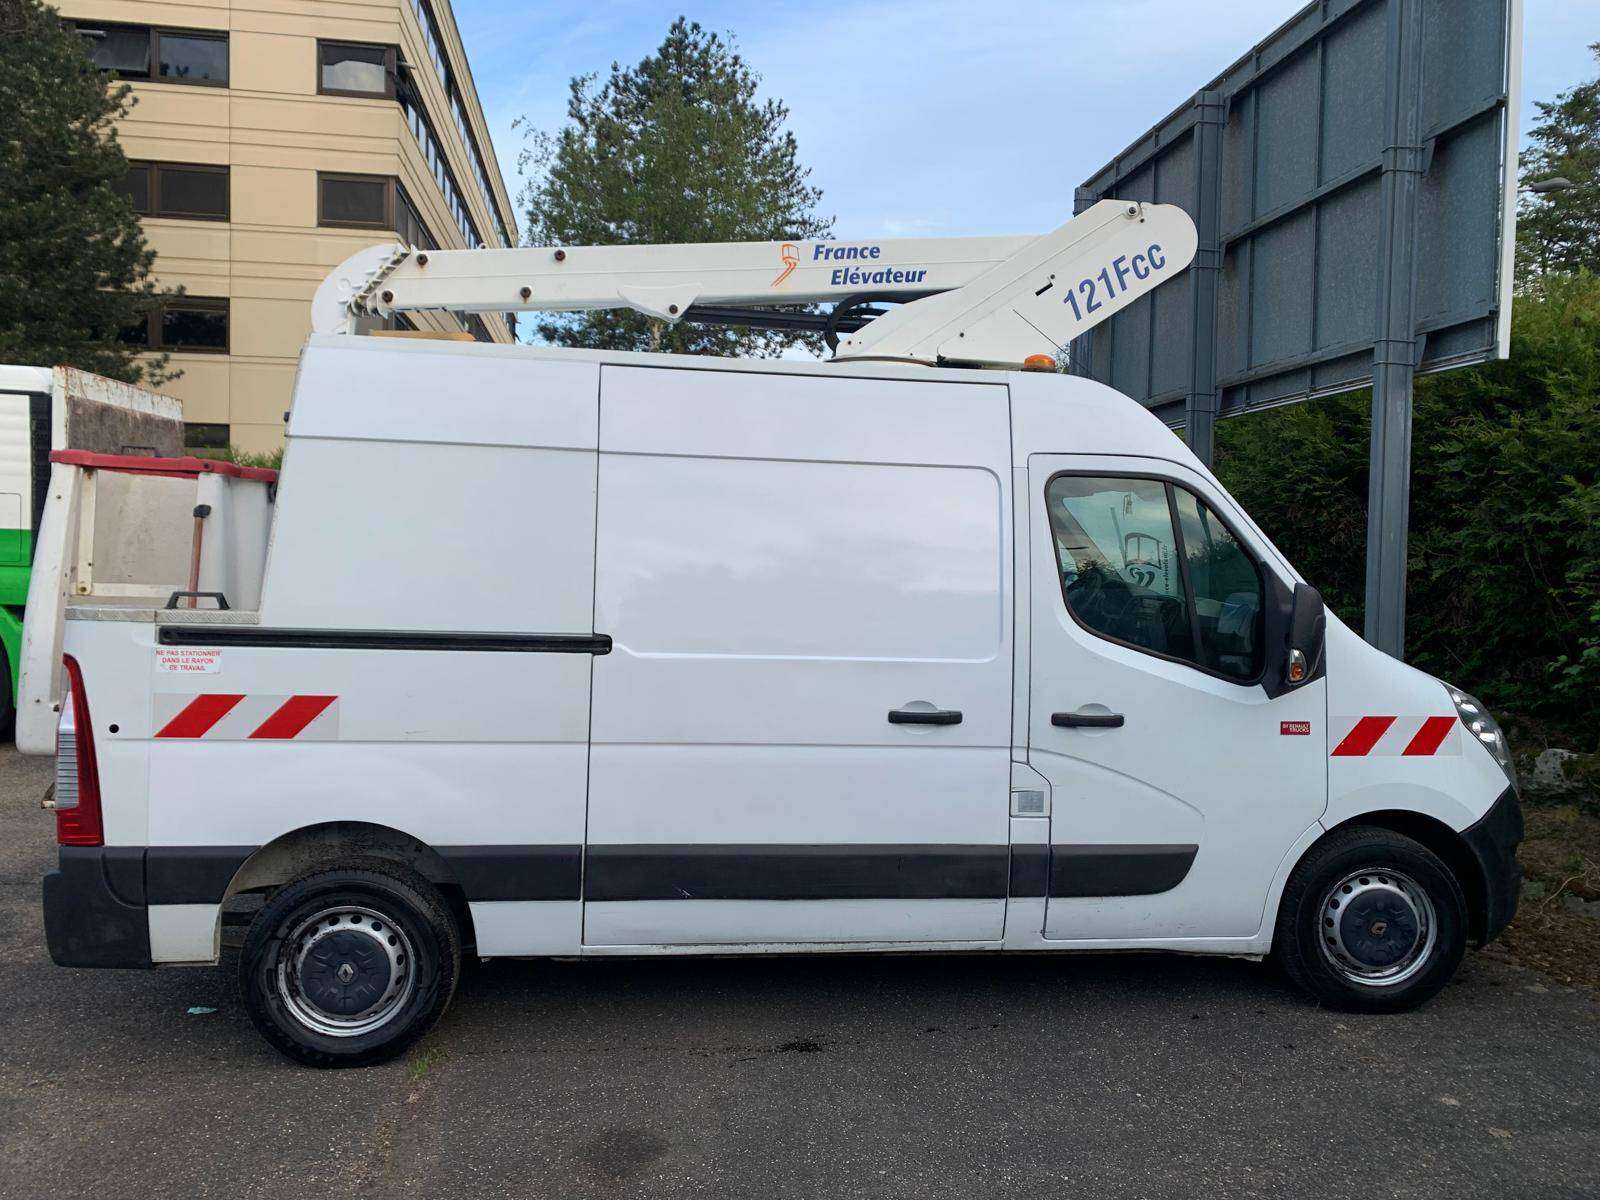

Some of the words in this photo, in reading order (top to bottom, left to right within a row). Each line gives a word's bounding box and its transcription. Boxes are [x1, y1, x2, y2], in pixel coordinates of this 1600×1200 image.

[813, 244, 881, 261] France
[831, 266, 927, 285] Elévateur
[1063, 244, 1166, 321] 121Fcc
